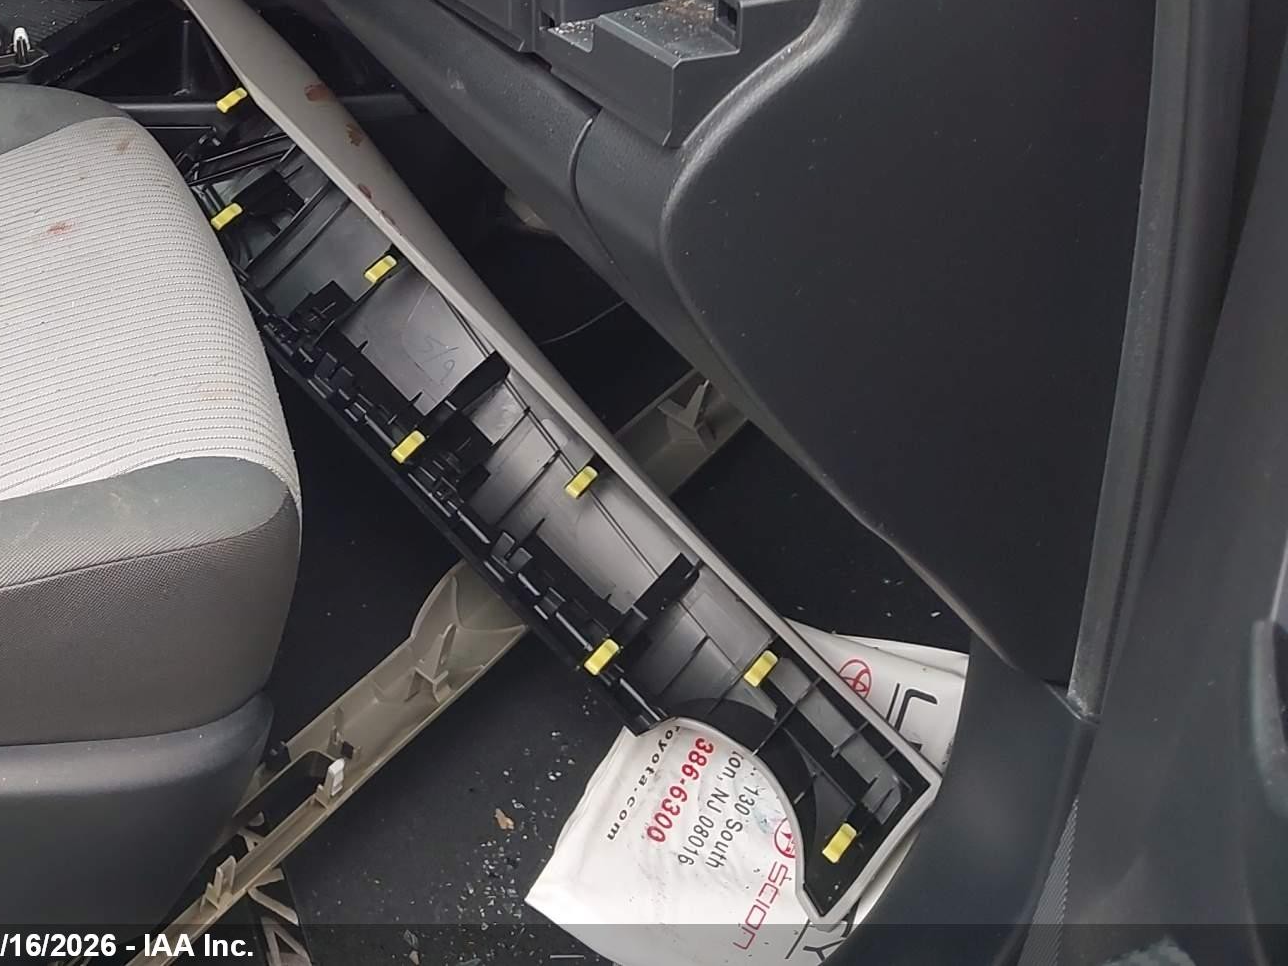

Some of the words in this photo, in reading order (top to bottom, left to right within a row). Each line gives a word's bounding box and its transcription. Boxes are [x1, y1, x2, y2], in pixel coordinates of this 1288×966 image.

[646, 738, 714, 842] 386-6300
[706, 787, 730, 813] NJ
[734, 785, 760, 815] 130
[677, 815, 714, 865] 08016
[705, 818, 744, 868] South
